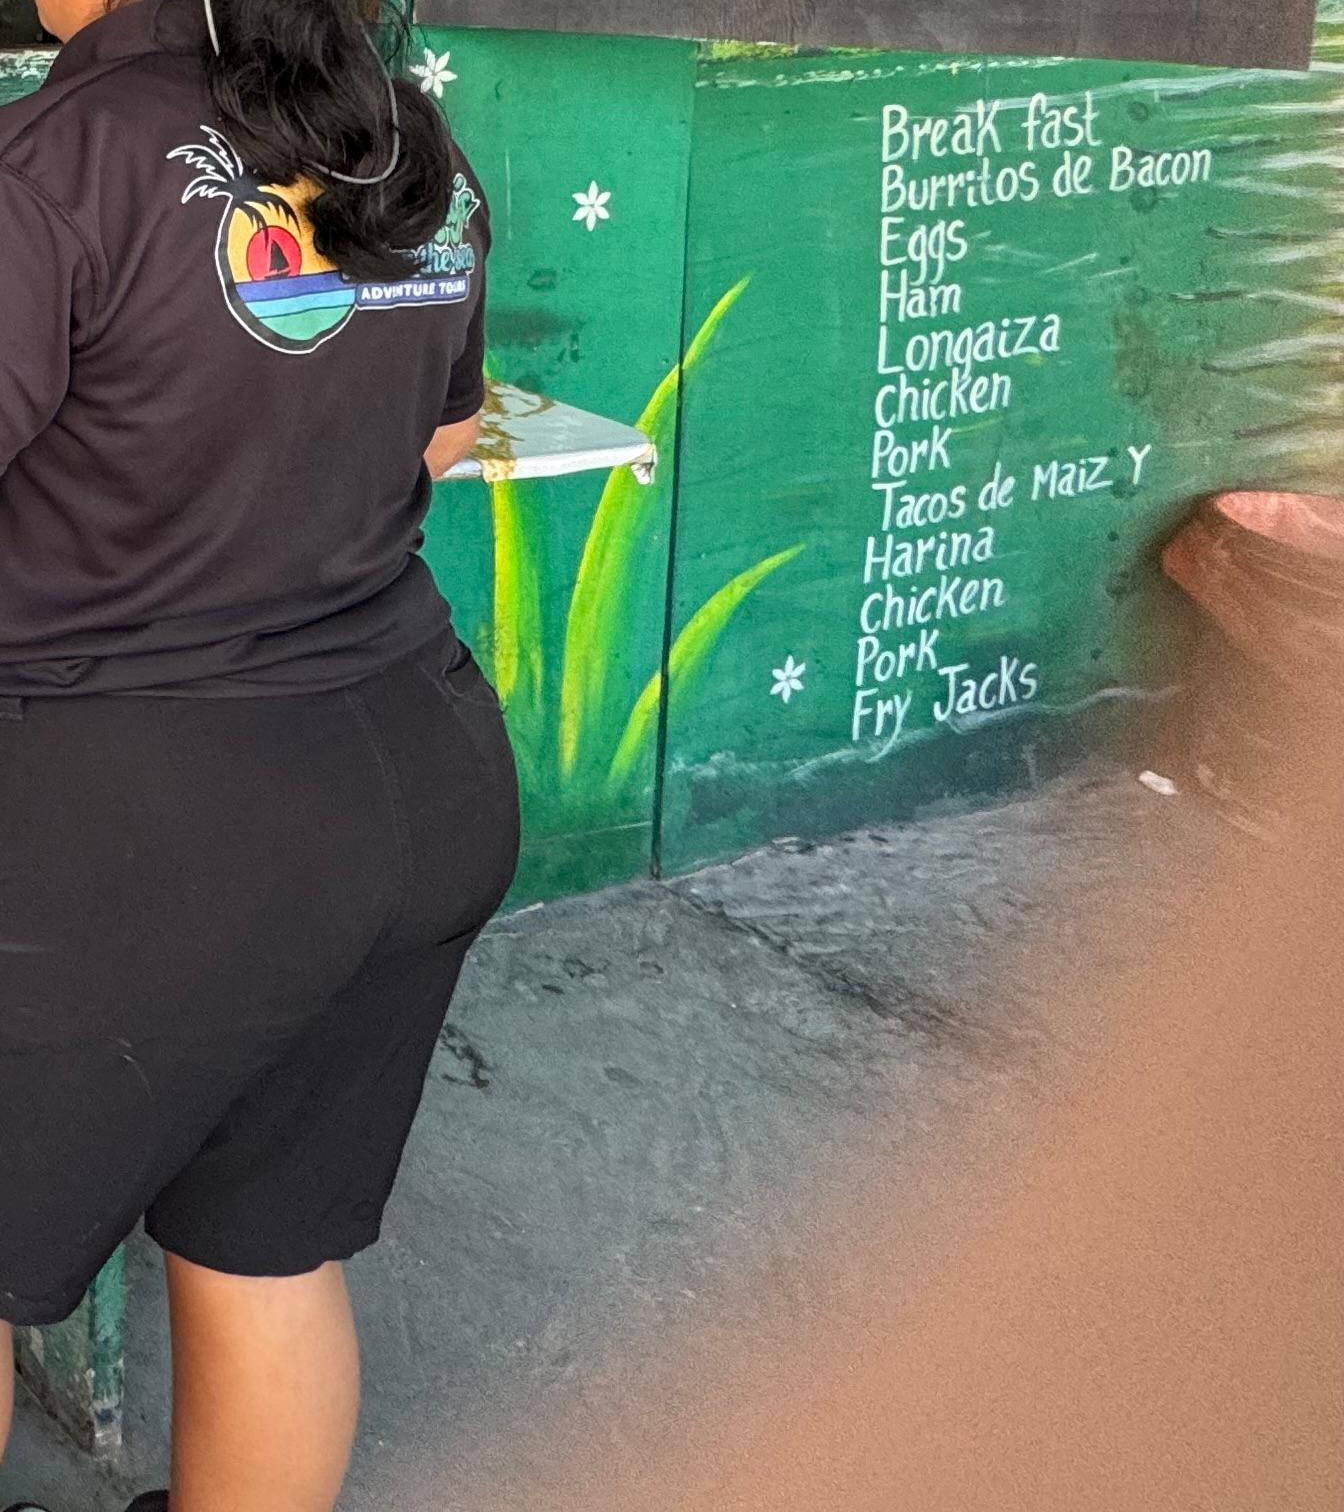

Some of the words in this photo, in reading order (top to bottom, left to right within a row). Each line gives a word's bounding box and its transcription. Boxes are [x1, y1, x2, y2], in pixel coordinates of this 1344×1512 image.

[1021, 90, 1103, 151] fast
[881, 157, 1040, 213] Burritos
[1052, 151, 1093, 197] de
[1109, 146, 1212, 192] Bacon
[880, 216, 968, 286] Eggs
[880, 268, 962, 323] Ham
[877, 313, 1061, 380] Longaiza
[872, 480, 967, 531] Tacos
[978, 462, 1016, 512] de
[1031, 456, 1113, 501] Maiz
[1127, 444, 1152, 485] Y
[864, 526, 994, 584] Harina
[852, 687, 912, 750] Fry
